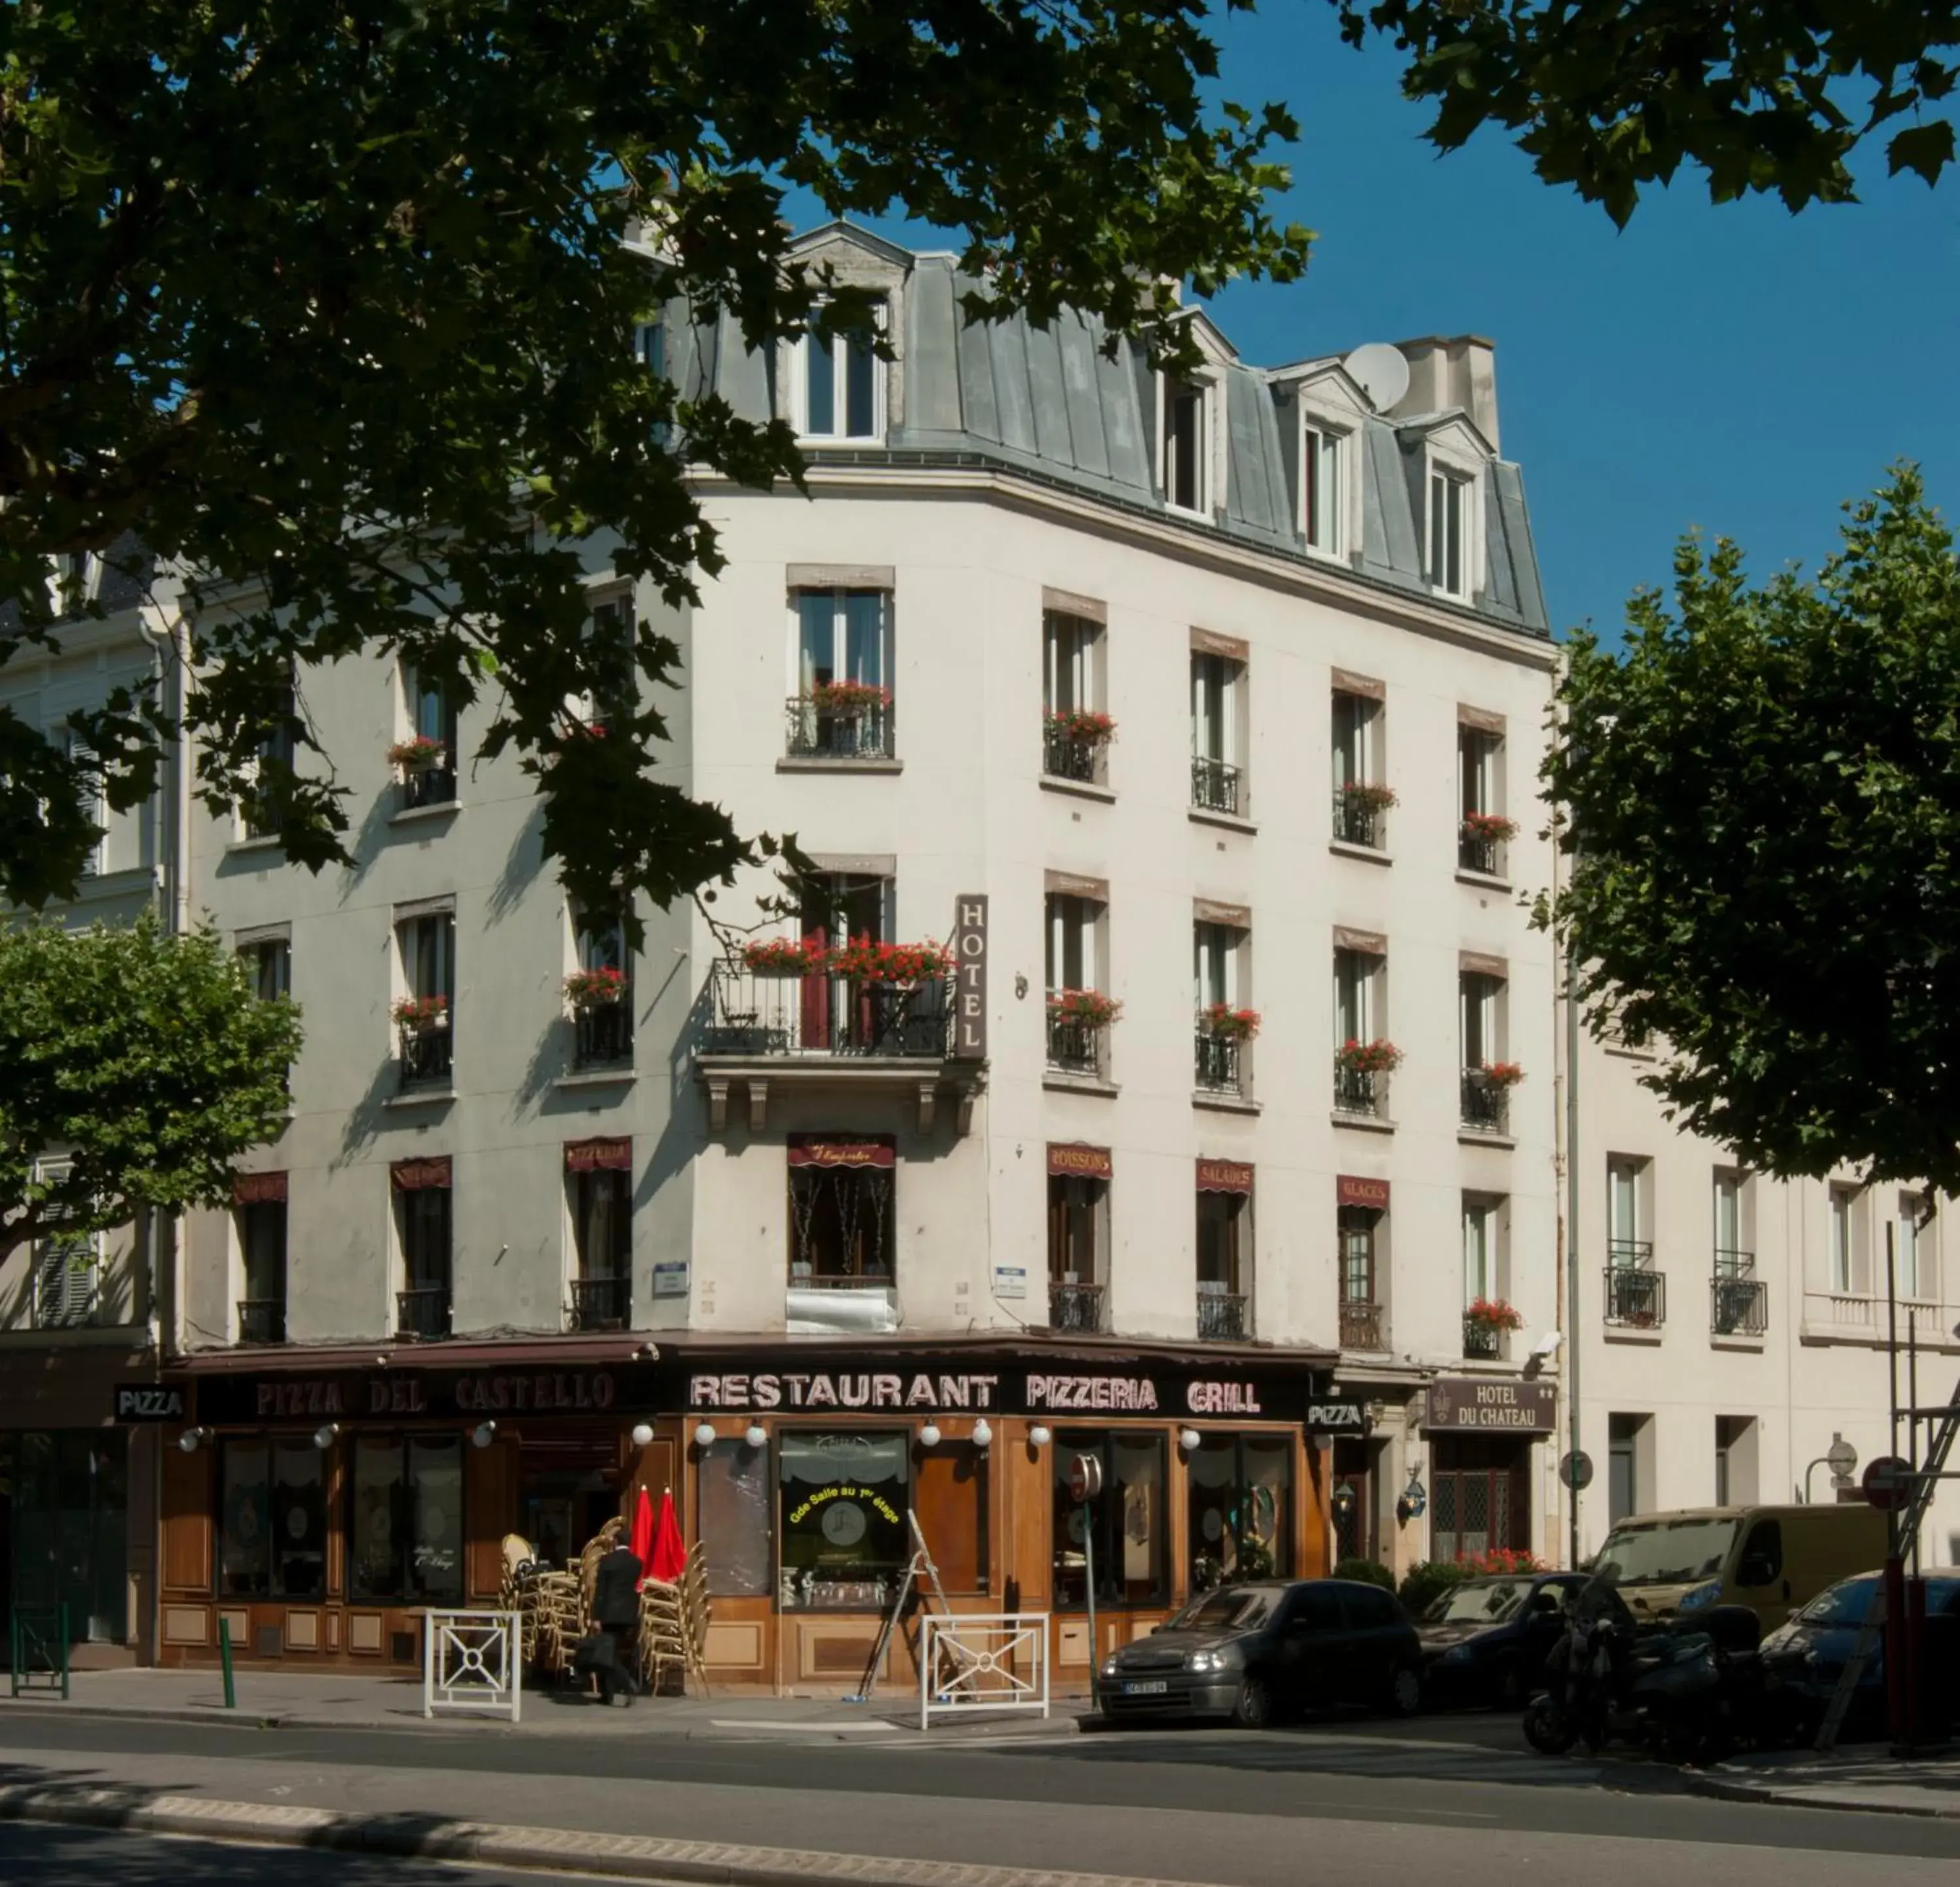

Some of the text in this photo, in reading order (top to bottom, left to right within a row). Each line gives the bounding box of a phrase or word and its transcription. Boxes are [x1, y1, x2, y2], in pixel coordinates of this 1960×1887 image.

[962, 905, 983, 1045] HOTEL
[120, 1391, 182, 1415] PIZZA
[257, 1373, 614, 1414] PIZZA DEL CASTELLO
[691, 1374, 1261, 1413] RESTAURANT PIZZERIA GRILL
[1477, 1386, 1516, 1404] HOTEL
[1309, 1404, 1361, 1425] PIZZA
[1459, 1407, 1536, 1426] DU CHATEAU
[809, 1487, 838, 1504] Salle
[841, 1487, 856, 1496] au
